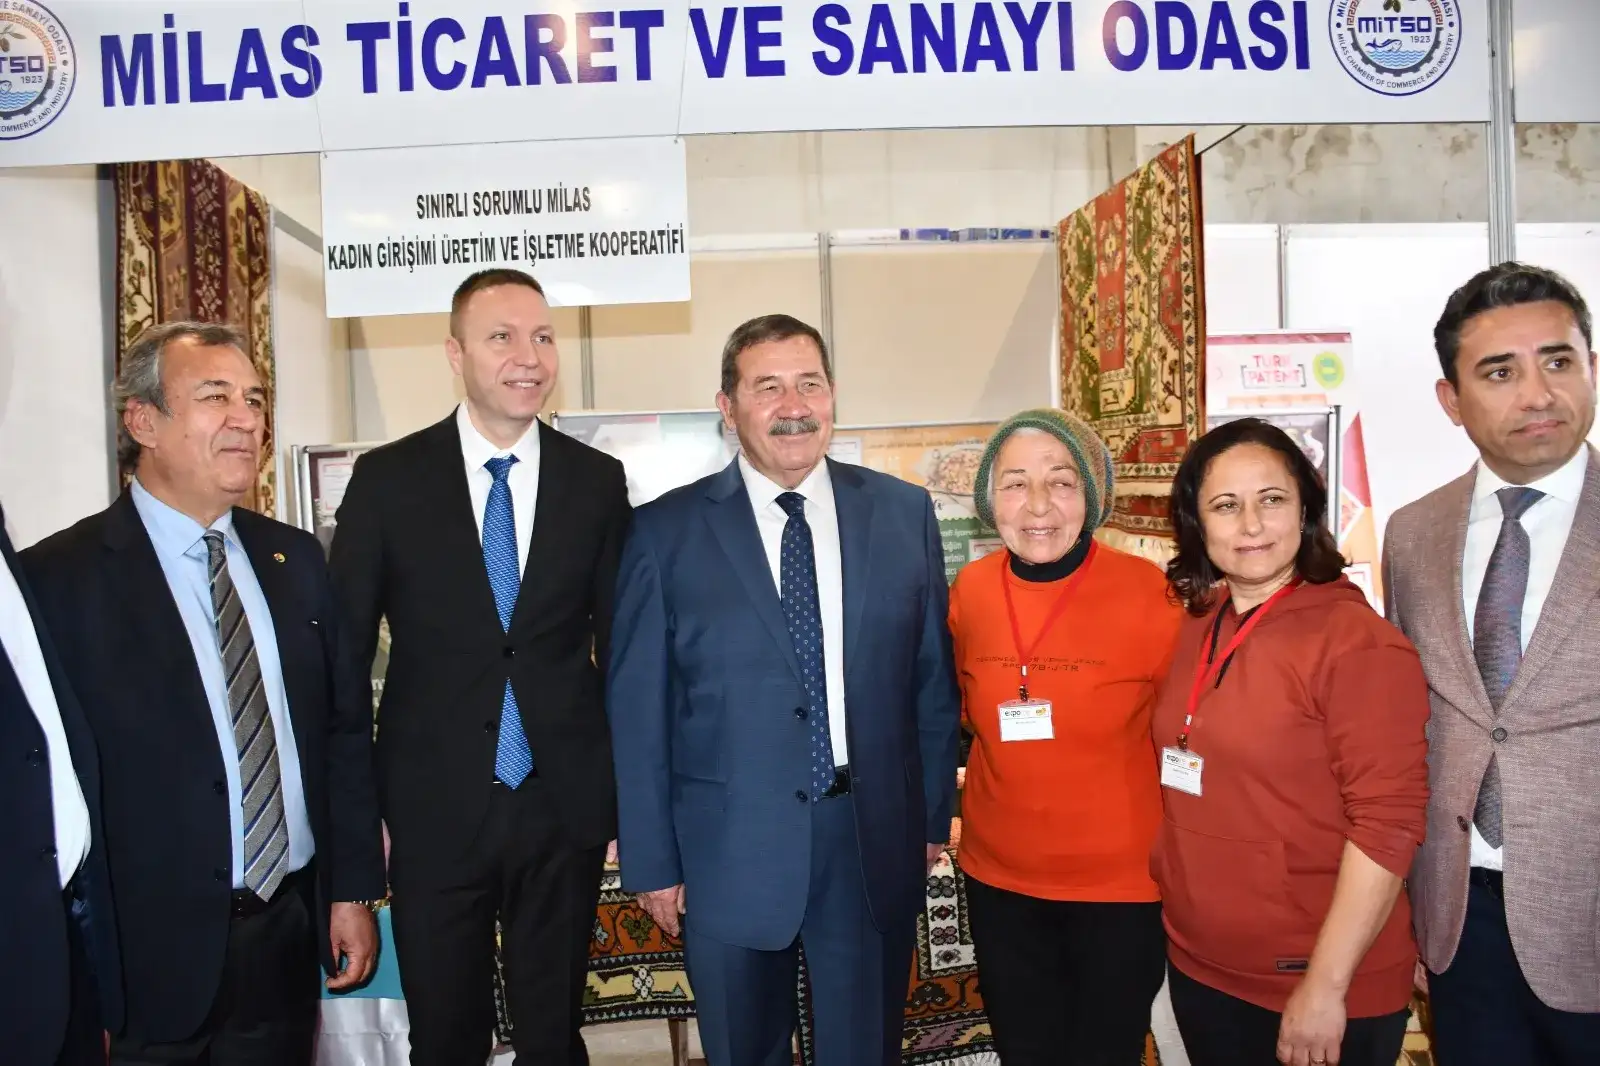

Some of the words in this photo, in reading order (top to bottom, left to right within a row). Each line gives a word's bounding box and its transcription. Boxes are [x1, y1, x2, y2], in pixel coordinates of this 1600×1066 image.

[1336, 0, 1348, 17] MİL
[47, 25, 67, 55] ODASI
[100, 13, 323, 108] MİLAS
[346, 1, 664, 94] TİCARET
[689, 5, 786, 78] VE
[1102, 0, 1310, 72] ODASI
[1410, 35, 1431, 43] 1923
[0, 56, 44, 73] TSO
[1346, 55, 1375, 82] CHAMBER
[1386, 75, 1425, 88] COMMERCE
[1425, 65, 1439, 79] AND
[1437, 32, 1454, 67] INDUSTRY
[20, 75, 43, 83] 1923
[0, 117, 38, 133] OMMERCE
[37, 107, 52, 122] AND
[50, 71, 69, 109] INDUSTRY
[416, 191, 469, 220] SINIRLI
[473, 189, 542, 217] SORUMLU
[547, 181, 592, 214] MİLAS
[327, 243, 373, 270] KADIN
[377, 233, 437, 273] GİRİŞİMİ
[441, 231, 497, 264] ÜRETİM
[499, 236, 520, 261] VE
[523, 229, 586, 267] İŞLETME
[589, 222, 685, 258] KOOPERATİFİ
